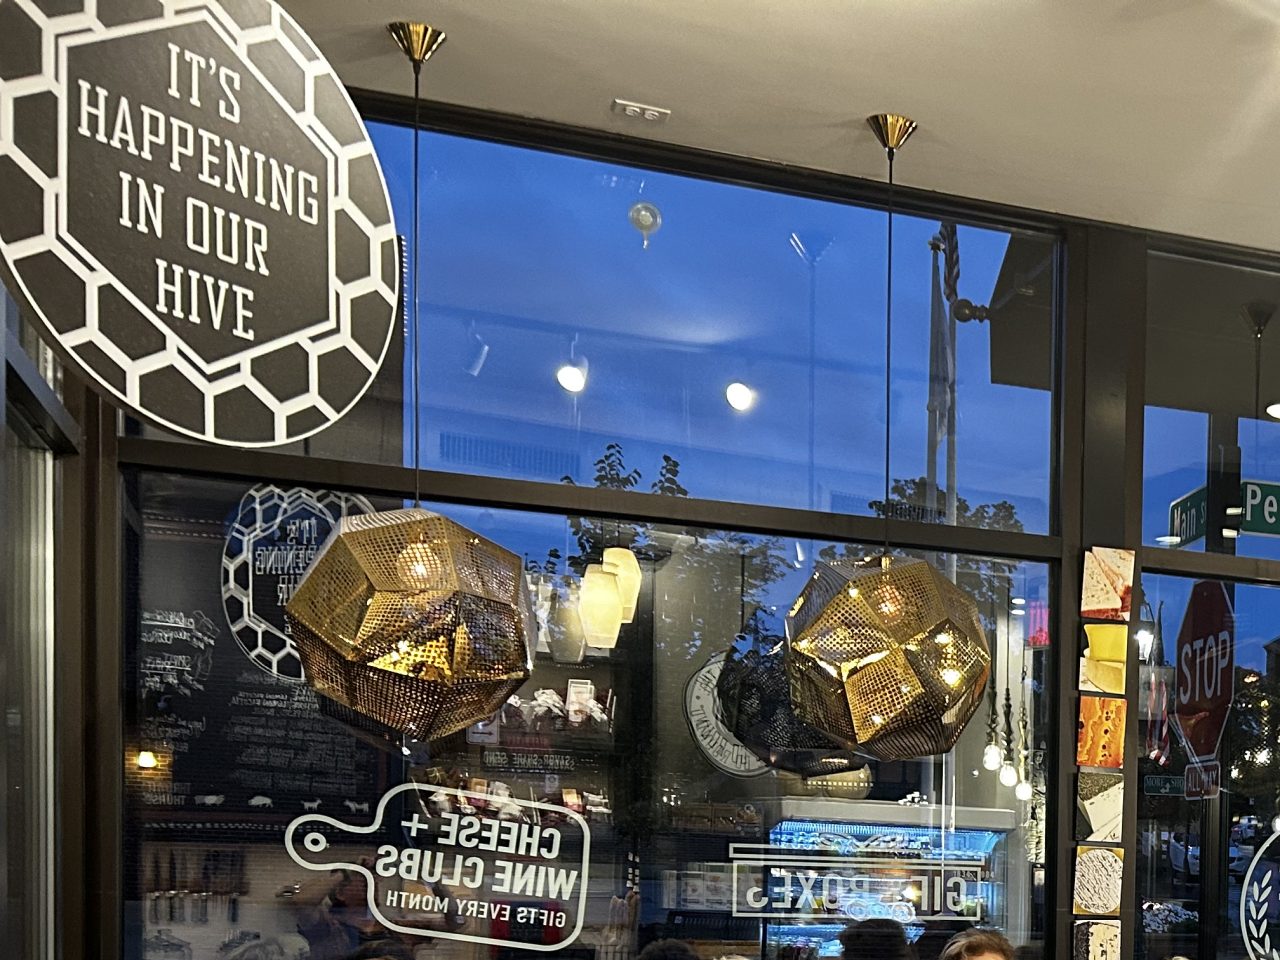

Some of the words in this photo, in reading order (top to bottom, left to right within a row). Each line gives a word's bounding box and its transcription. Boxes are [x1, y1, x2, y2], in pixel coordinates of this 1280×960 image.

[166, 42, 243, 125] IT'S
[77, 78, 320, 226] HAPPENING
[118, 171, 165, 238] IN
[185, 196, 270, 277] OUR
[155, 258, 256, 342] HIVE
[1173, 501, 1196, 541] Main
[1179, 630, 1231, 706] STOP
